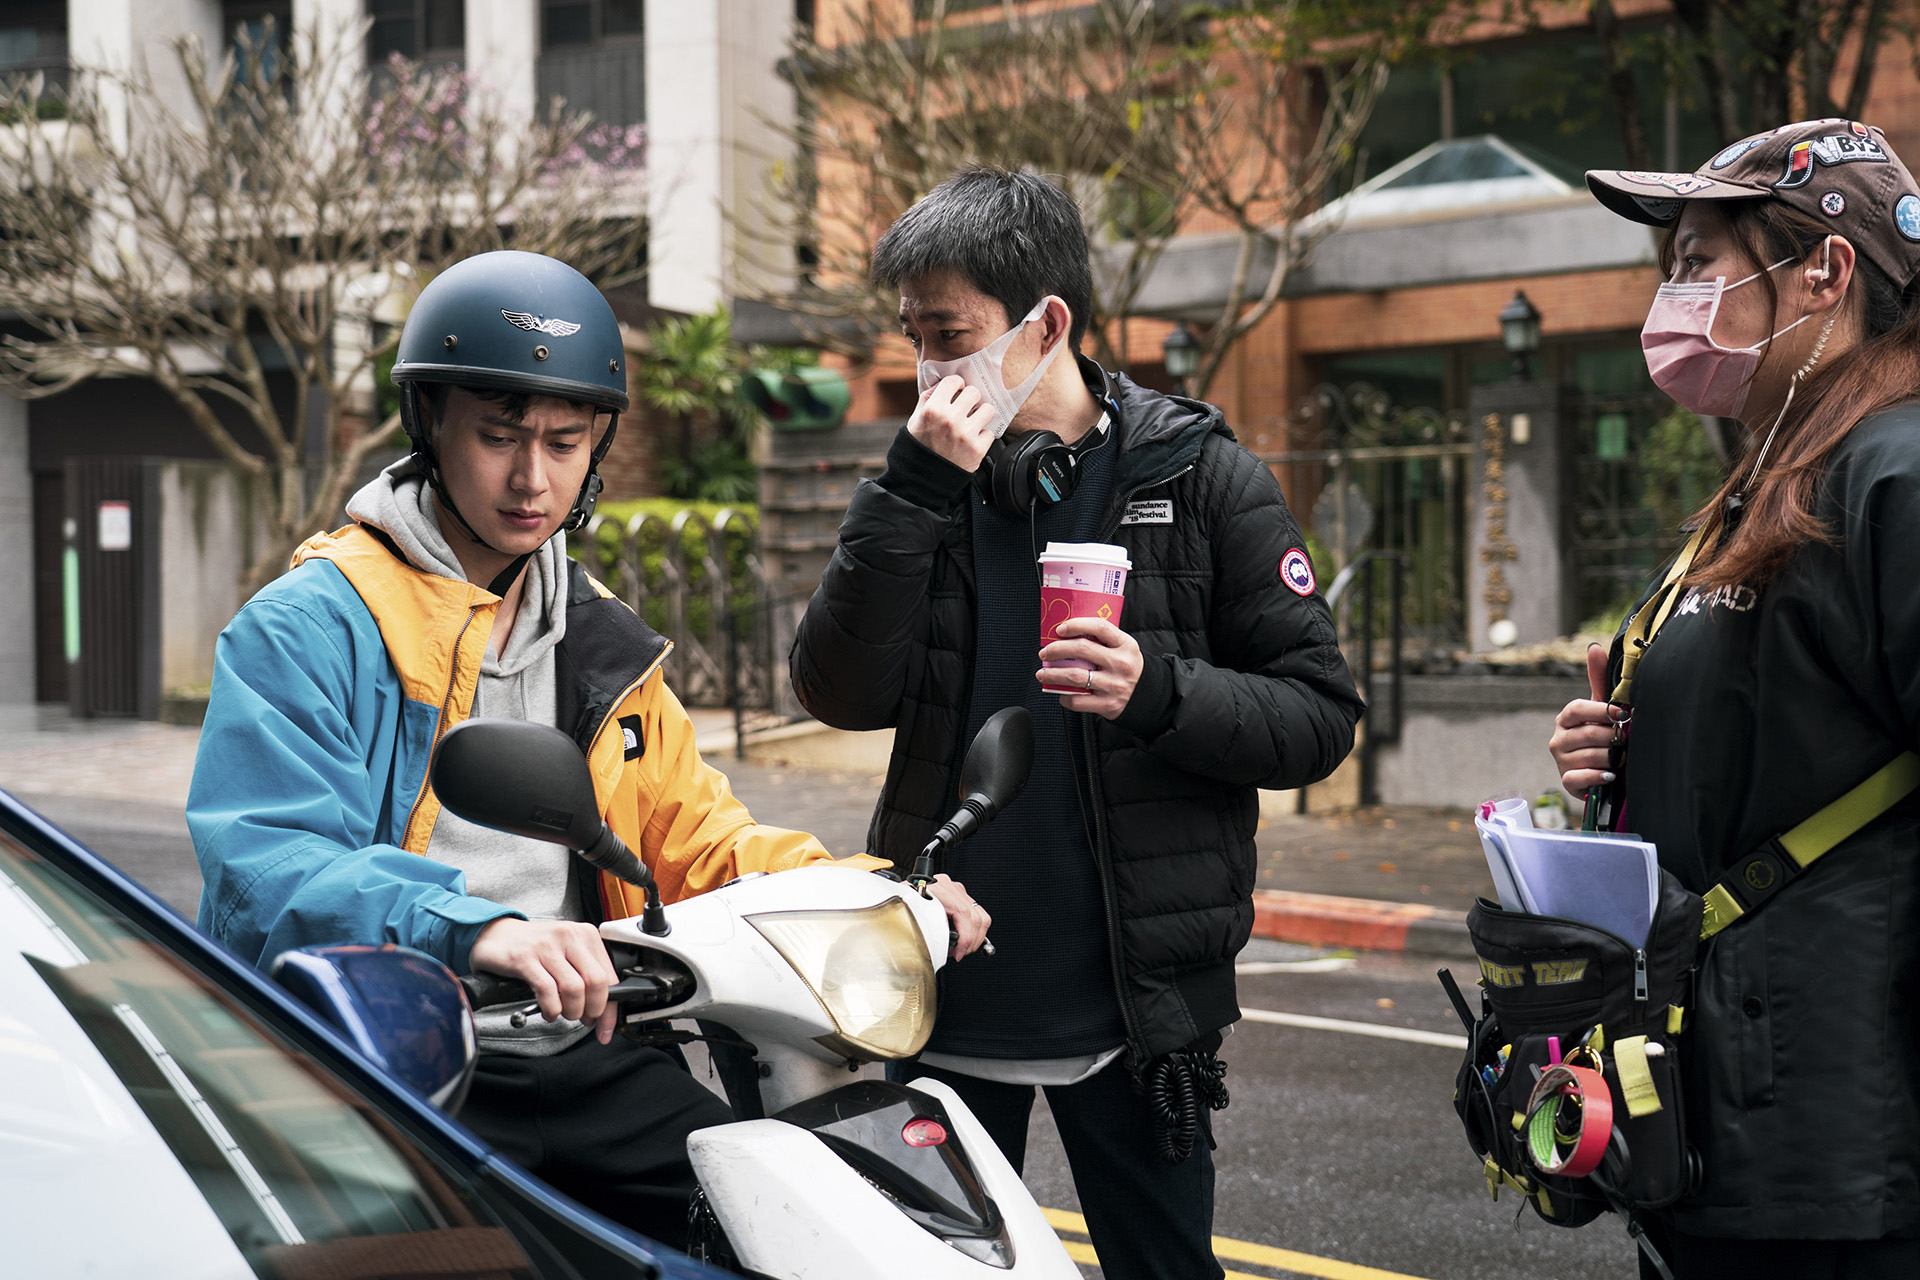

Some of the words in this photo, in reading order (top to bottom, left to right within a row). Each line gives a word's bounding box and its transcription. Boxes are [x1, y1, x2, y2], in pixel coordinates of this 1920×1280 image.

[1052, 461, 1064, 478] SONY
[1131, 501, 1168, 509] sundance
[1531, 960, 1588, 985] TEAM
